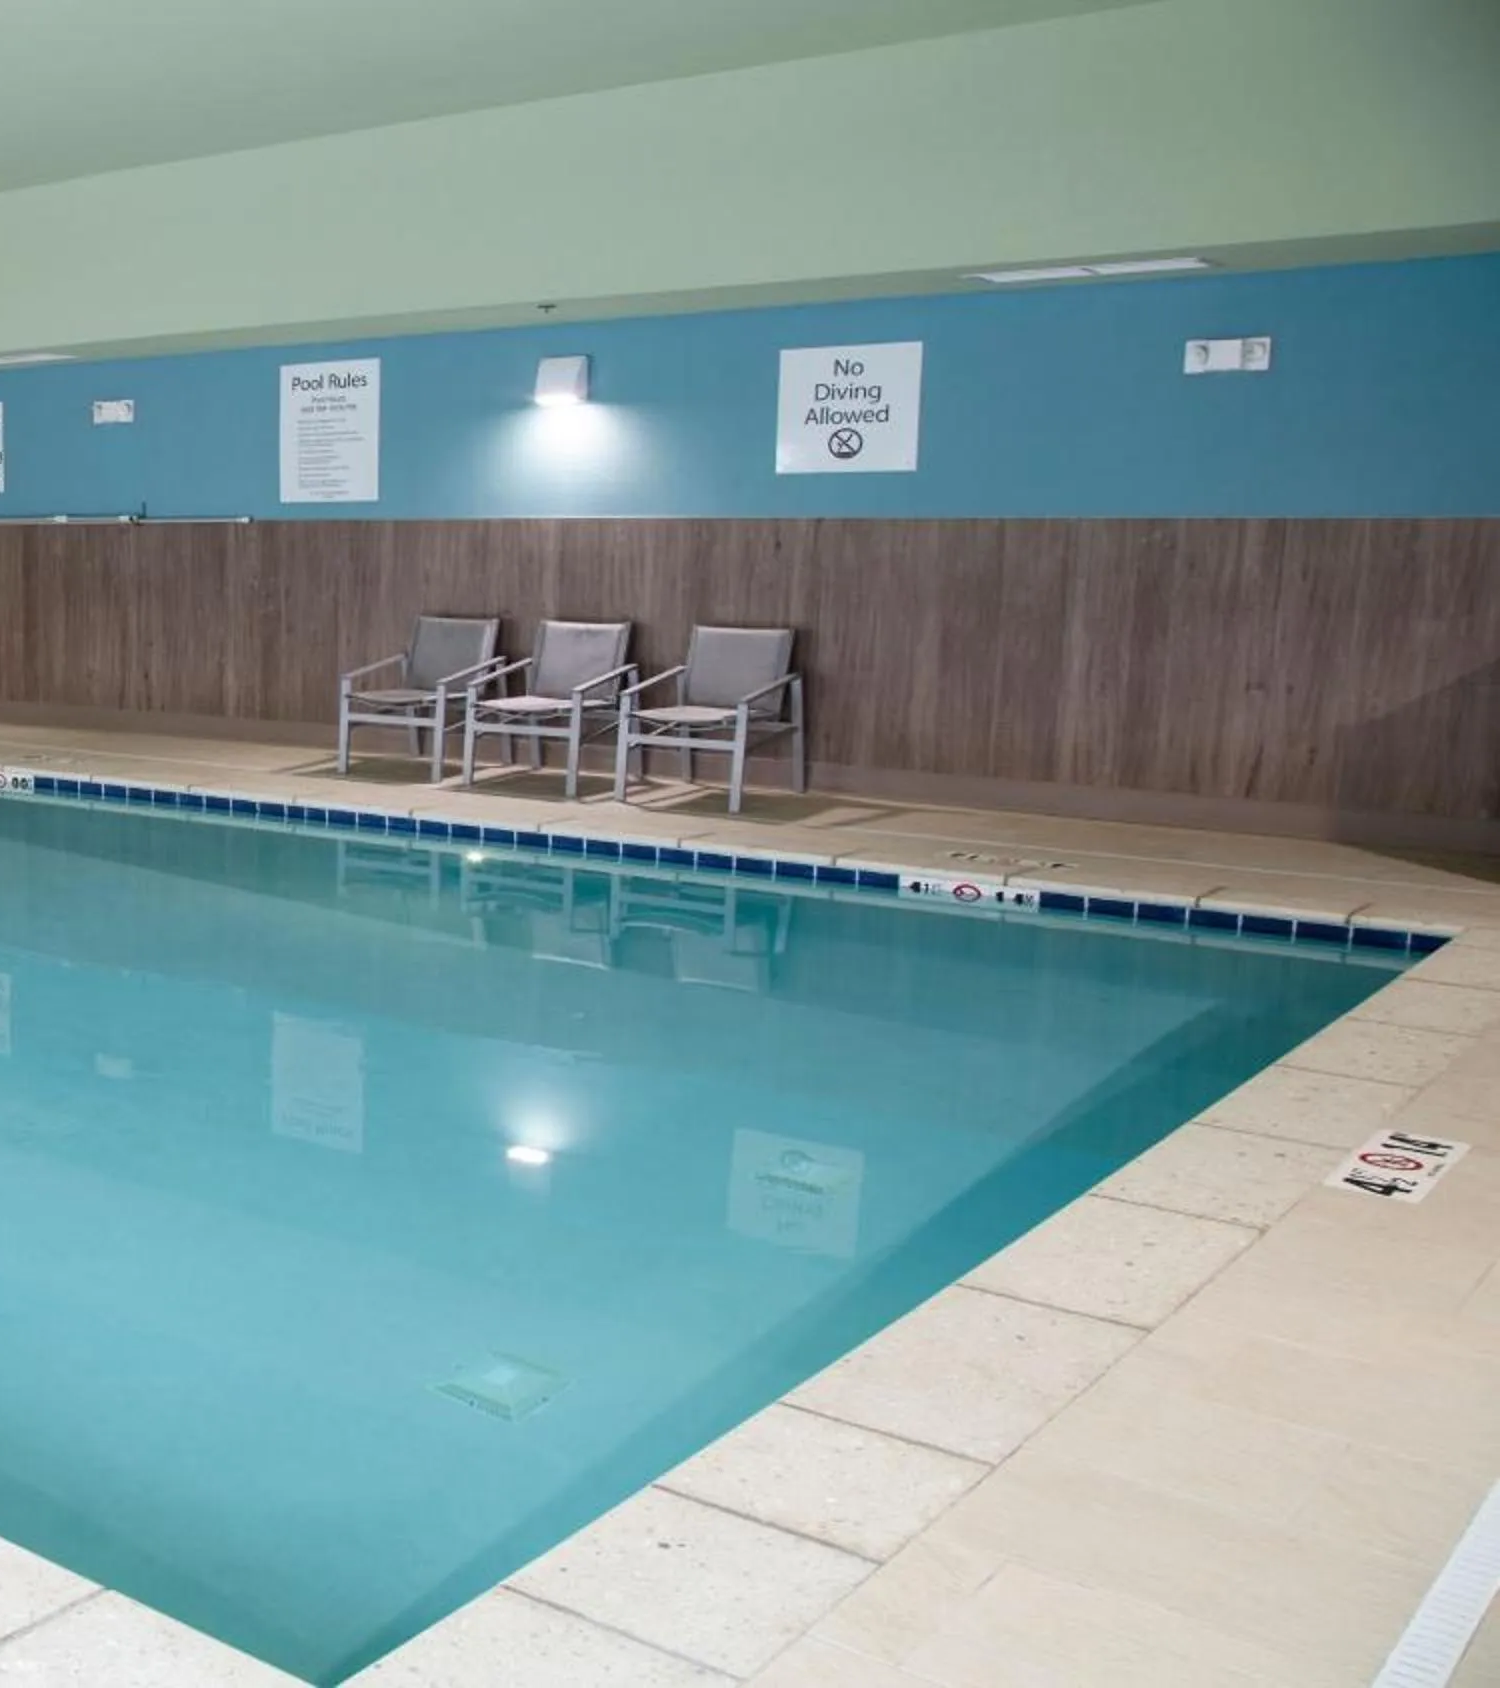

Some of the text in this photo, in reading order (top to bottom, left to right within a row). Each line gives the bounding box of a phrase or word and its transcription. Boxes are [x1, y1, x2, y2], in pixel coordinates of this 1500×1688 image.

[833, 359, 865, 377] No
[291, 372, 368, 392] Pool Rules
[814, 383, 882, 404] Diving
[804, 404, 889, 425] Allowed
